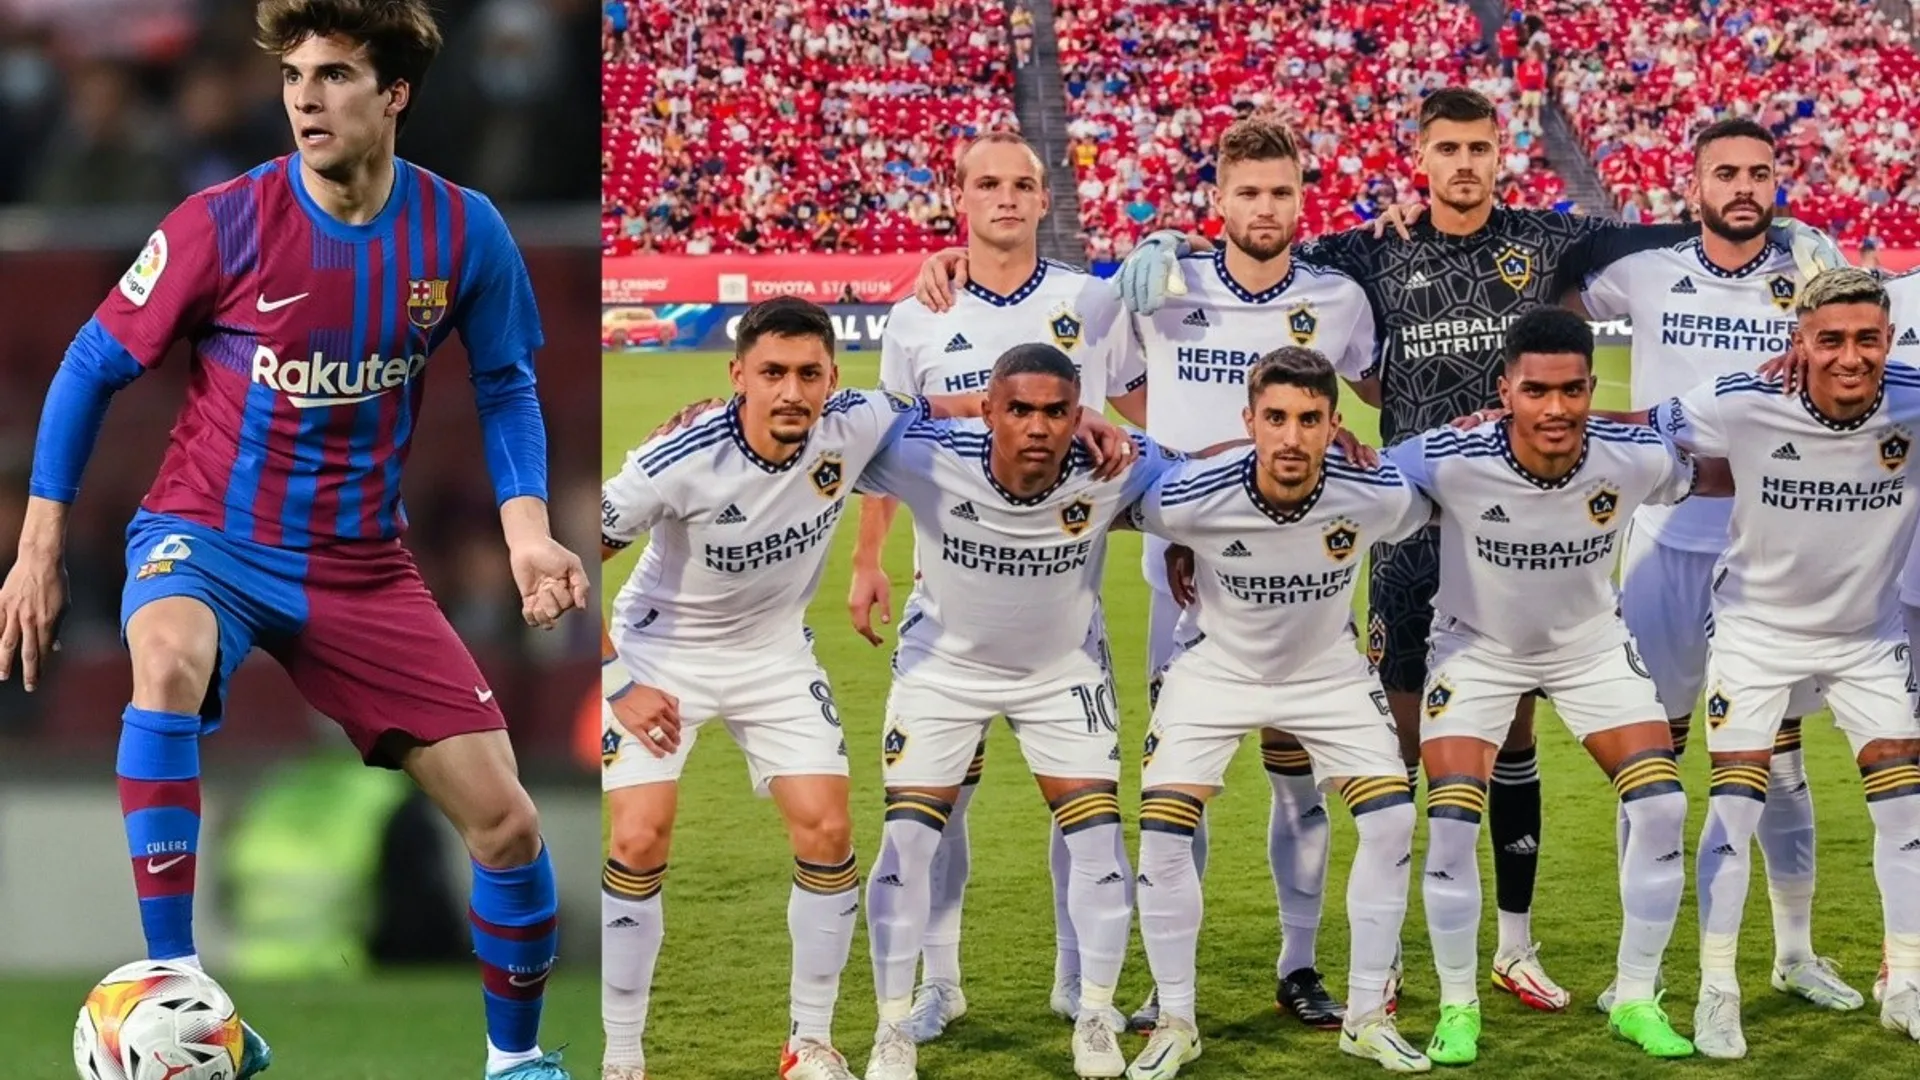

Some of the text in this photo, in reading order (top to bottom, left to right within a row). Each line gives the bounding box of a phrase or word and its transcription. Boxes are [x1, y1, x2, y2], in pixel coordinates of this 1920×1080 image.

[752, 280, 893, 295] TOYOTA STADIUM
[1057, 326, 1077, 337] LA
[1293, 321, 1312, 332] LA
[1401, 316, 1521, 341] HERBALI
[1662, 312, 1799, 335] HERBALIFE
[1177, 347, 1261, 367] HERBA
[1403, 334, 1502, 359] NUTRITI
[252, 345, 426, 394] Rakuten
[1884, 445, 1904, 457] LA
[819, 470, 839, 487] LA
[1762, 475, 1906, 496] HERBALIFE
[1593, 501, 1613, 513] LA
[1761, 491, 1903, 512] NUTRITION
[705, 496, 845, 560] HERBALIFE
[1067, 512, 1086, 522] LA
[943, 532, 1092, 562] HERBALIFE
[1330, 537, 1351, 549] LA
[1475, 529, 1618, 556] HERBALIFE
[942, 547, 1088, 577] NUTRITION
[1477, 543, 1613, 570] NUTRITION
[1215, 562, 1357, 590] HERBALIFE
[1220, 576, 1352, 604] NUTRITION
[809, 681, 842, 729] 8
[1070, 683, 1118, 733] 10
